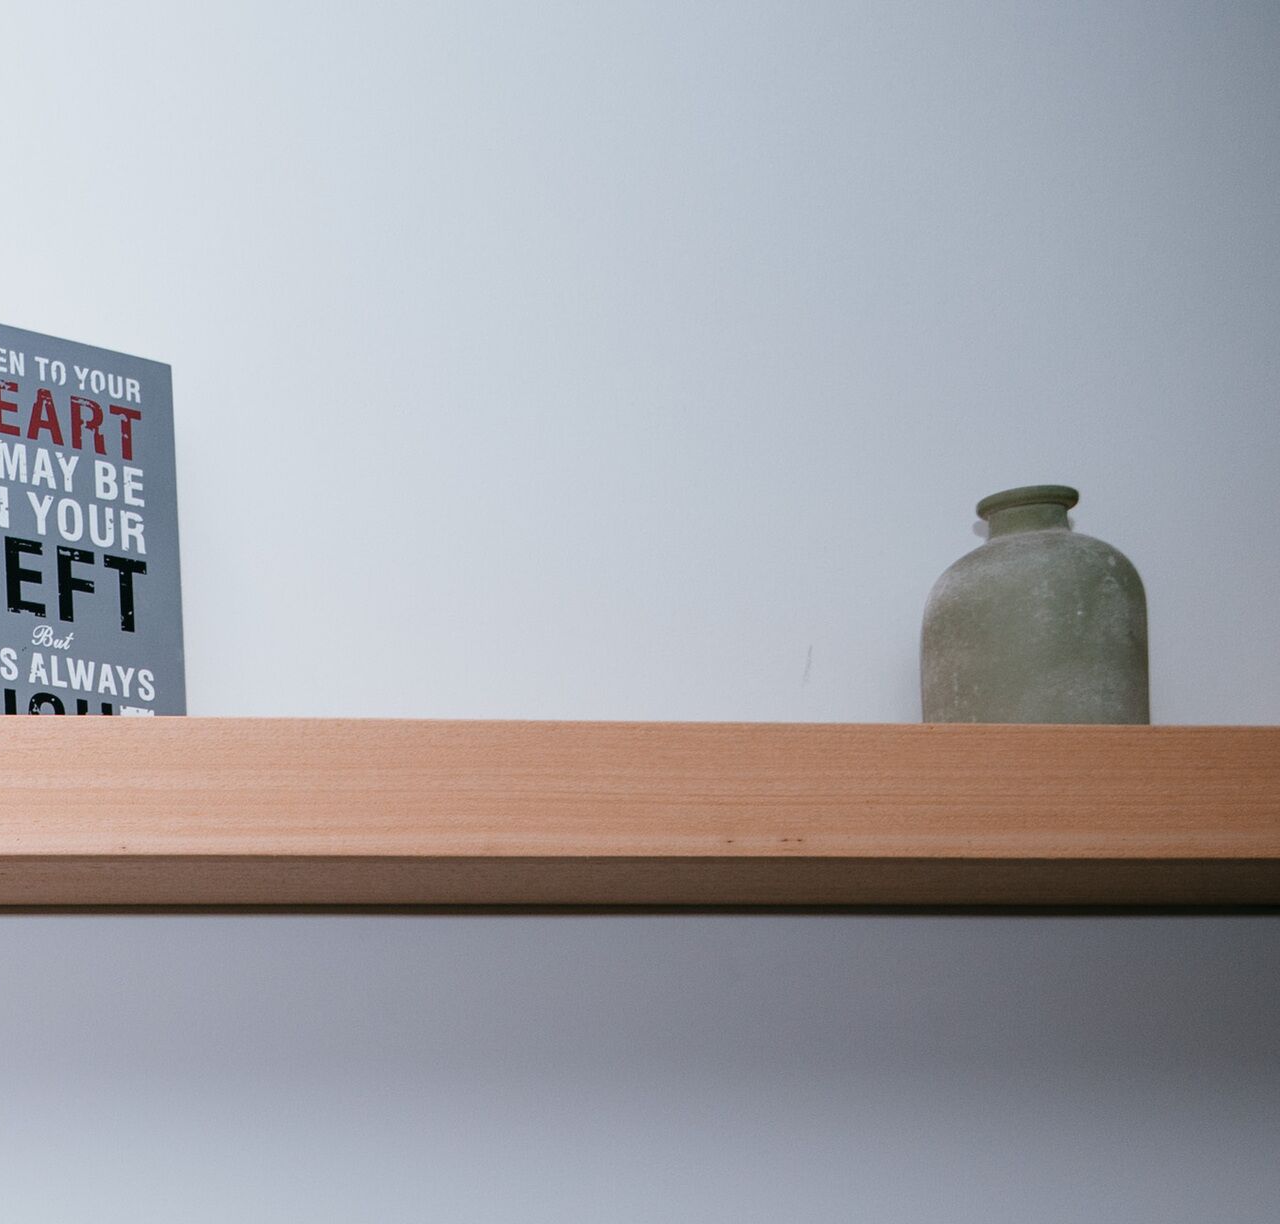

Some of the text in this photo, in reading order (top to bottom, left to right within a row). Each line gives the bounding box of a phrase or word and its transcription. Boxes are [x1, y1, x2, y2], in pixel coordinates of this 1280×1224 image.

[34, 356, 68, 387] TO
[73, 367, 142, 404] YOUR
[94, 460, 146, 508] BE
[25, 491, 147, 555] YOUR
[31, 625, 75, 651] But
[28, 652, 156, 702] ALWAYS
